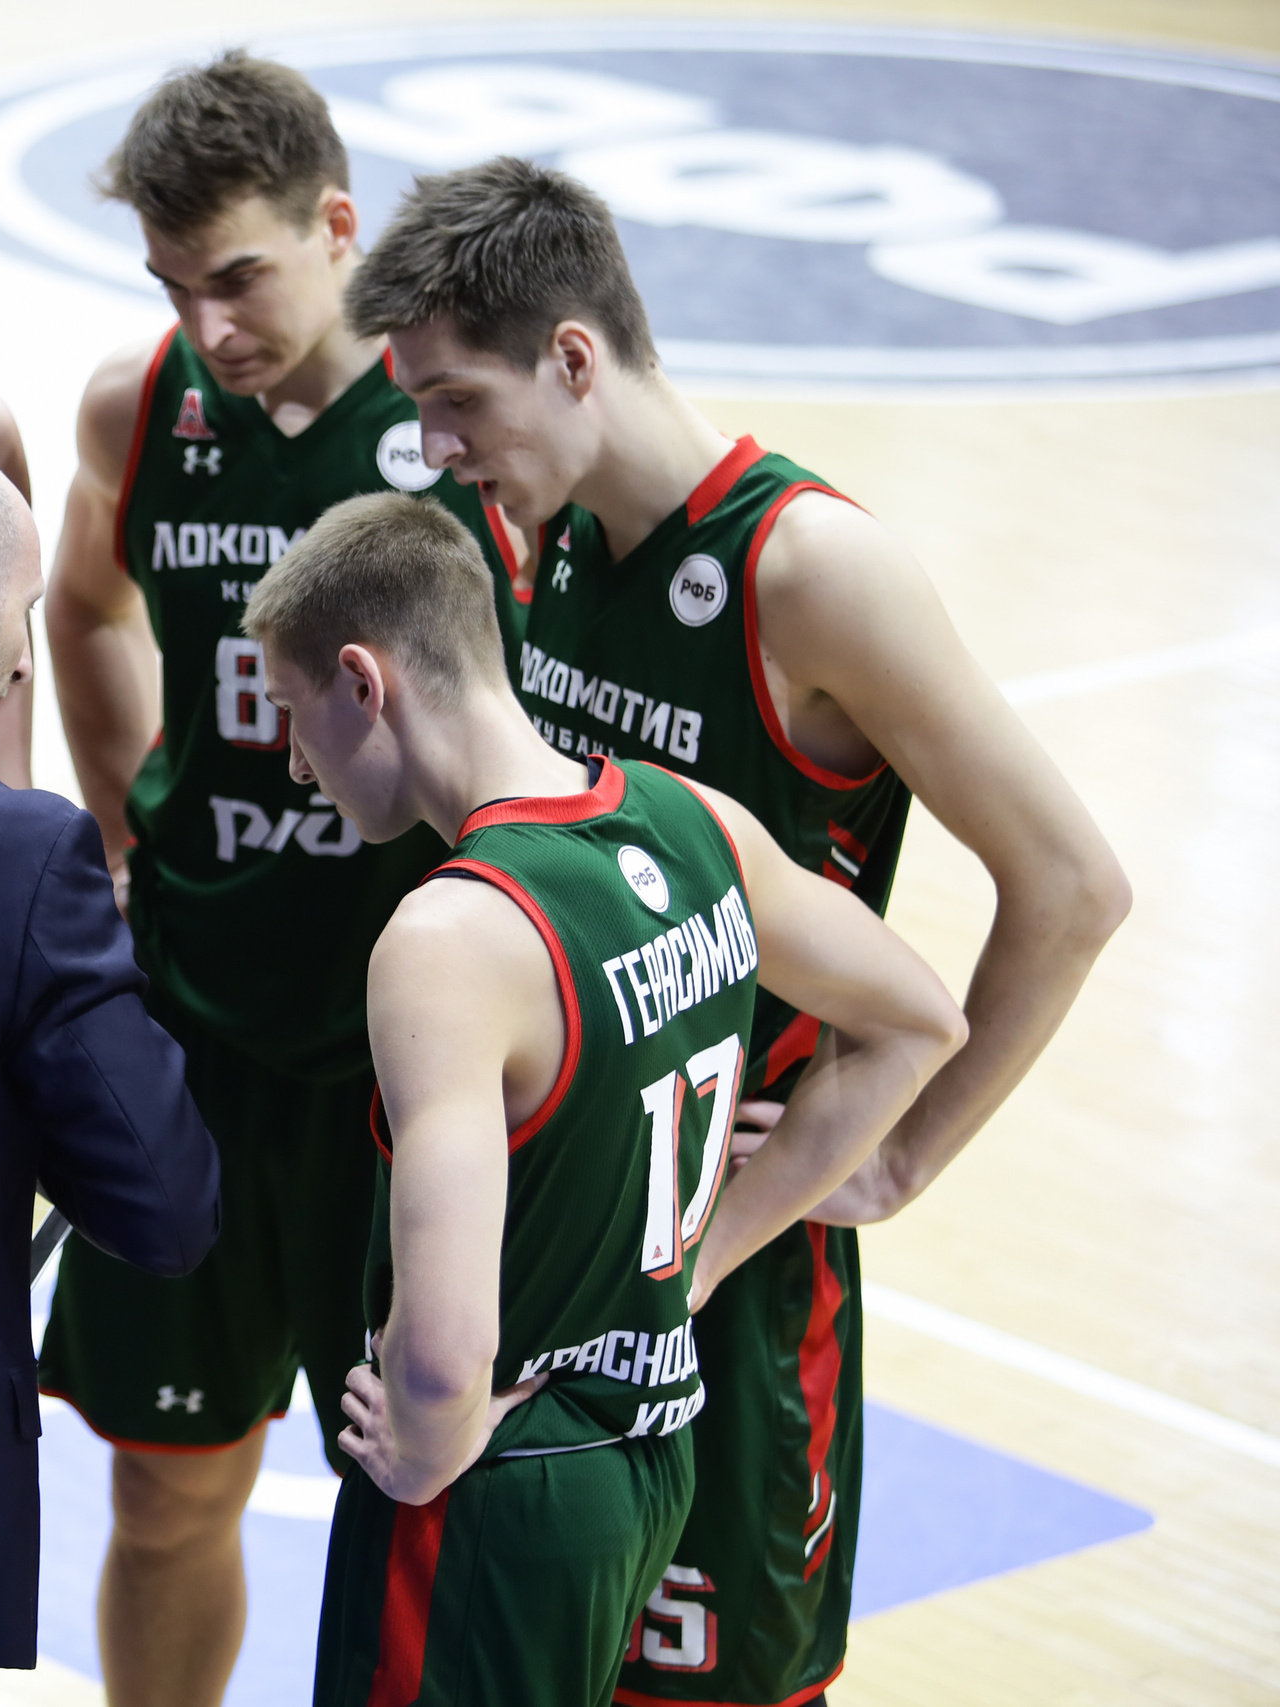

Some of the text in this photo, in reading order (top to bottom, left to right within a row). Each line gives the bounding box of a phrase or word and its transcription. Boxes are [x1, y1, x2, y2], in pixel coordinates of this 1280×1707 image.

[389, 449, 420, 464] РФ
[152, 521, 307, 571] ЛОКОМ
[680, 579, 716, 602] РФБ
[520, 640, 702, 764] ЛОКОМОТИВ
[631, 866, 657, 891] РФБ
[602, 884, 759, 1046] ГЕРАСИМОВ
[640, 1032, 744, 1281] 17
[515, 1316, 699, 1388] КРАСНОД
[624, 1380, 706, 1438] КРА
